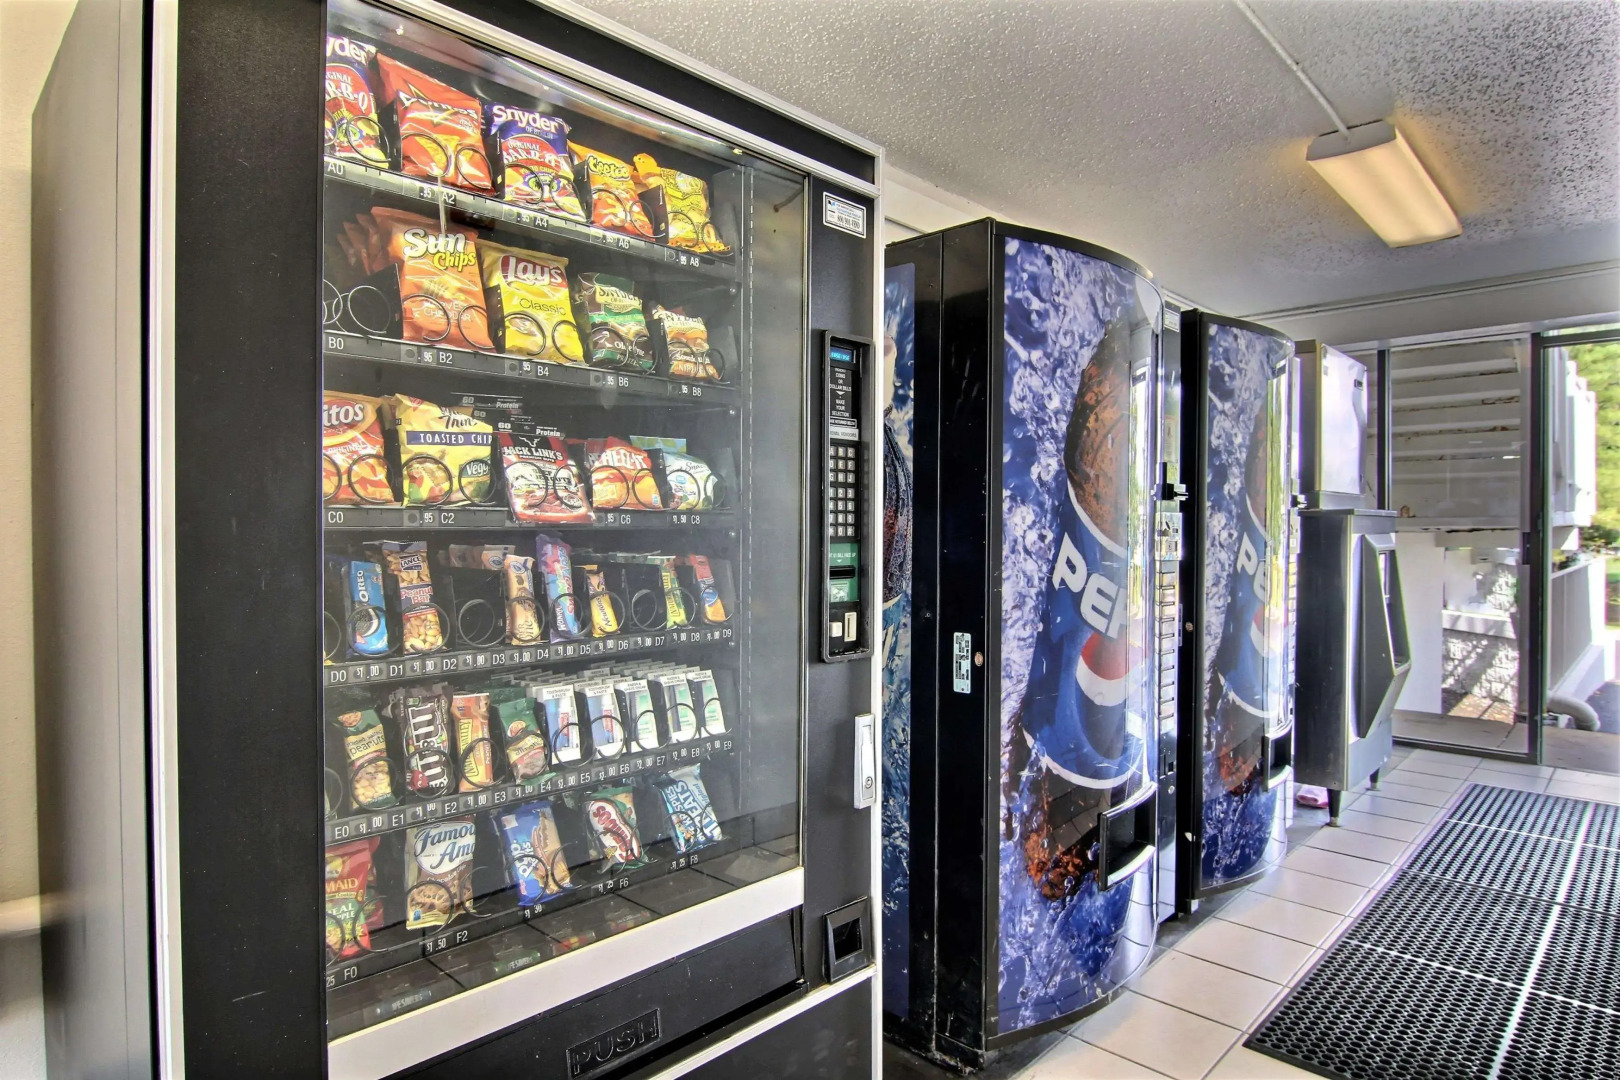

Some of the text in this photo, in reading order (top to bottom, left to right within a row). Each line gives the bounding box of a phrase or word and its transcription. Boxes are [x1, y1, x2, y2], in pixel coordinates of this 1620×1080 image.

[493, 105, 558, 133] Snyder
[327, 164, 344, 175] A0
[441, 193, 455, 204] A2
[536, 217, 547, 228] A4
[403, 228, 466, 258] Sun
[618, 239, 629, 249] A6
[434, 250, 477, 272] Chips
[690, 257, 699, 268] A8
[520, 299, 566, 315] Classic
[328, 337, 344, 350] B0
[439, 352, 453, 364] B2
[537, 365, 549, 376] B4
[618, 377, 629, 387] B6
[692, 387, 702, 396] B8
[323, 403, 364, 426] itos
[420, 433, 492, 444] TOASTED CHIP
[536, 429, 561, 437] Protein
[328, 511, 344, 523] C0
[441, 513, 455, 524] C2
[621, 515, 631, 524] C6
[691, 515, 700, 524] C8
[401, 556, 422, 568] LANCE
[357, 570, 369, 603] OREO
[723, 629, 732, 638] D9
[618, 641, 629, 650] D6
[655, 637, 665, 646] D7
[537, 649, 549, 660] D4
[580, 645, 590, 655] D5
[443, 659, 456, 670] D2
[492, 655, 505, 665] D3
[390, 665, 403, 676] D1
[331, 671, 347, 682] D0
[350, 735, 385, 757] peanuts
[724, 740, 732, 750] E9
[691, 748, 700, 758] E8
[657, 756, 666, 766] E7
[620, 763, 629, 774] E6
[580, 772, 590, 783] E5
[541, 781, 551, 792] E4
[495, 792, 506, 803] E3
[445, 802, 457, 814] E2
[393, 815, 404, 826] E1
[335, 826, 349, 839] E0
[414, 825, 475, 857] Famou
[430, 842, 475, 869] Amo
[690, 855, 699, 865] F8
[619, 878, 629, 888] F6
[456, 931, 468, 943] F2
[344, 966, 357, 981] F0
[573, 1015, 658, 1075] PUSH
